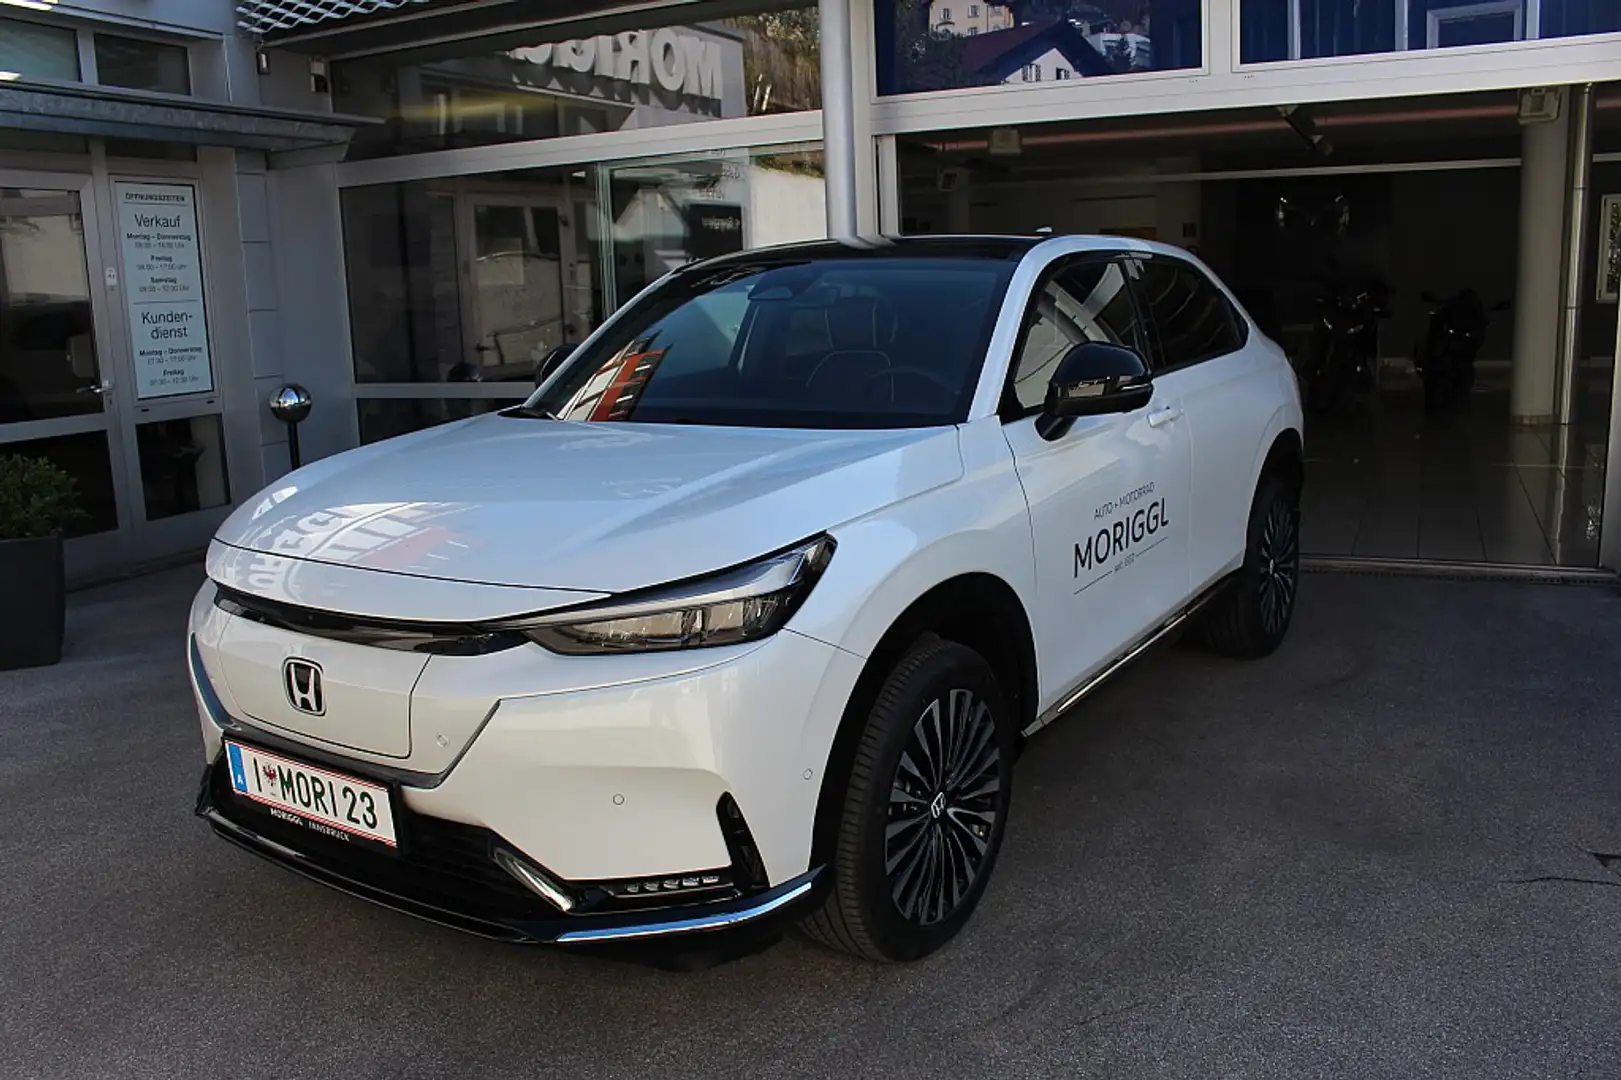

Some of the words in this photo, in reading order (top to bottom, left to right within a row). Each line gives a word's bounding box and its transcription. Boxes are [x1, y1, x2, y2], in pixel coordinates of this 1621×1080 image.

[134, 213, 181, 228] Verkauf
[126, 232, 150, 241] Montag
[141, 311, 193, 324] Kunden-
[150, 326, 188, 340] dienst
[1094, 502, 1113, 520] AUTO
[1119, 481, 1155, 509] MOTORRAD
[1073, 497, 1169, 580] MORIGGL
[277, 764, 339, 818] MORI
[342, 786, 378, 830] 23
